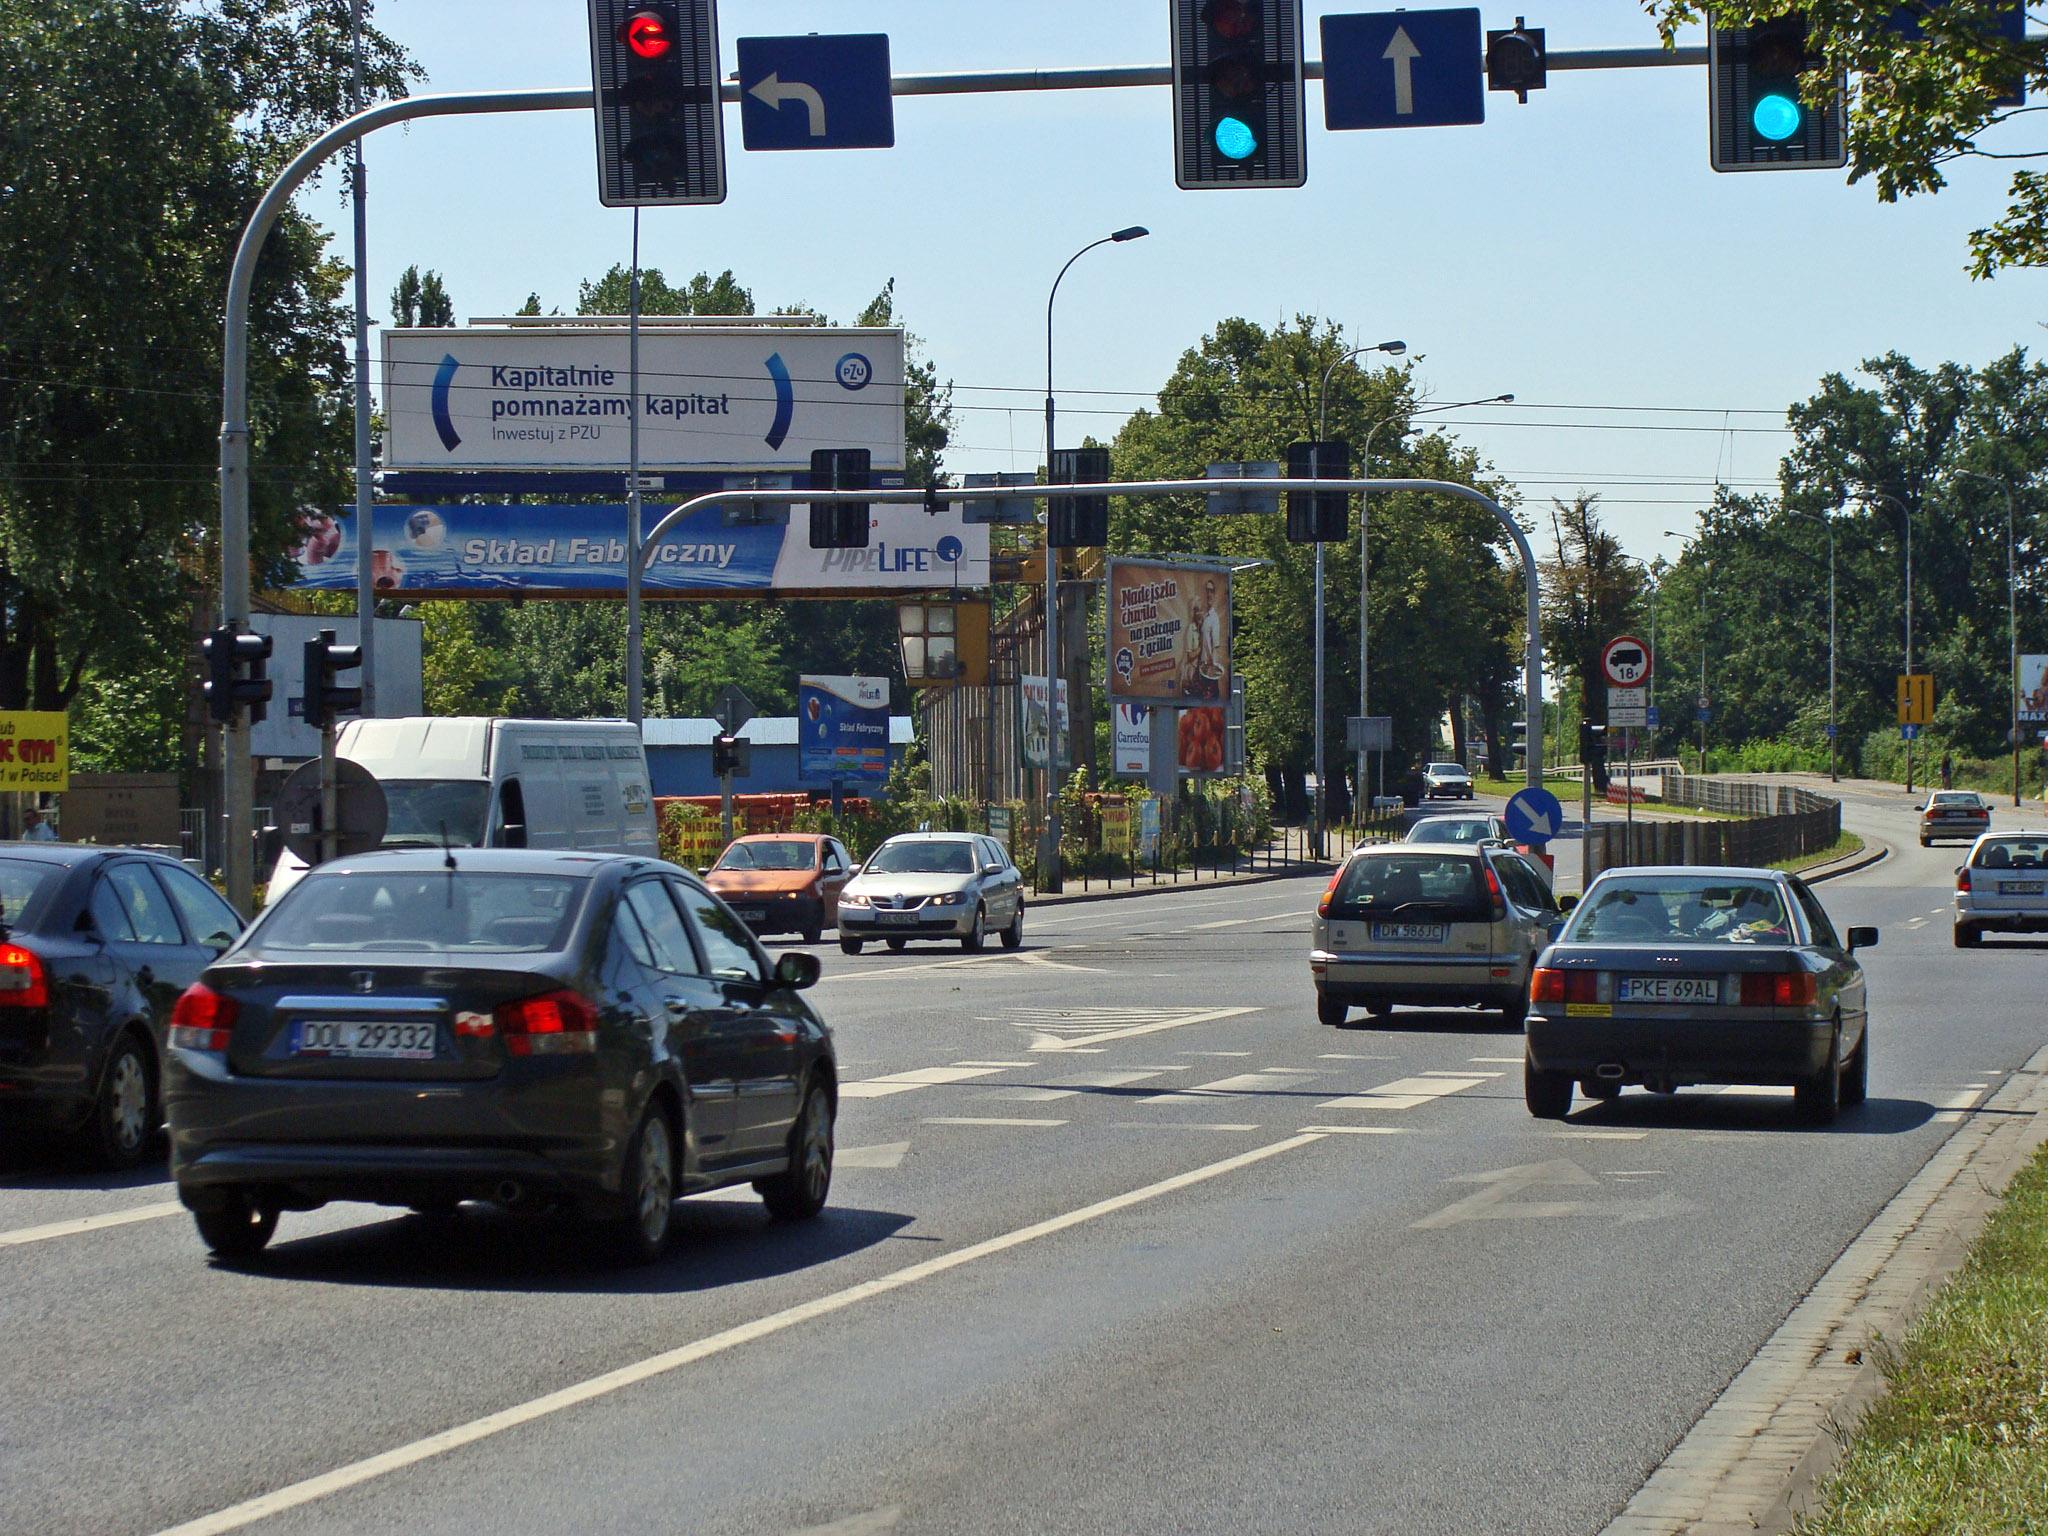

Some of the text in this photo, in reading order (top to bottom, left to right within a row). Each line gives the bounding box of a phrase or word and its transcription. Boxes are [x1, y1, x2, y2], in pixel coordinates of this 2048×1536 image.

[492, 365, 614, 392] Kapitalnie
[844, 364, 864, 380] PZU
[492, 393, 729, 421] pomnażamy kapitał
[493, 426, 600, 444] Inwestuj z PZU
[463, 538, 736, 570] Skład Fabyczny
[1619, 667, 1634, 680] 18
[1118, 731, 1150, 744] Carrefou
[21, 768, 63, 782] Polsce!
[1381, 924, 1440, 937] DW 586JC
[1631, 980, 1715, 998] PKE 69AL
[358, 1024, 432, 1050] 29332
